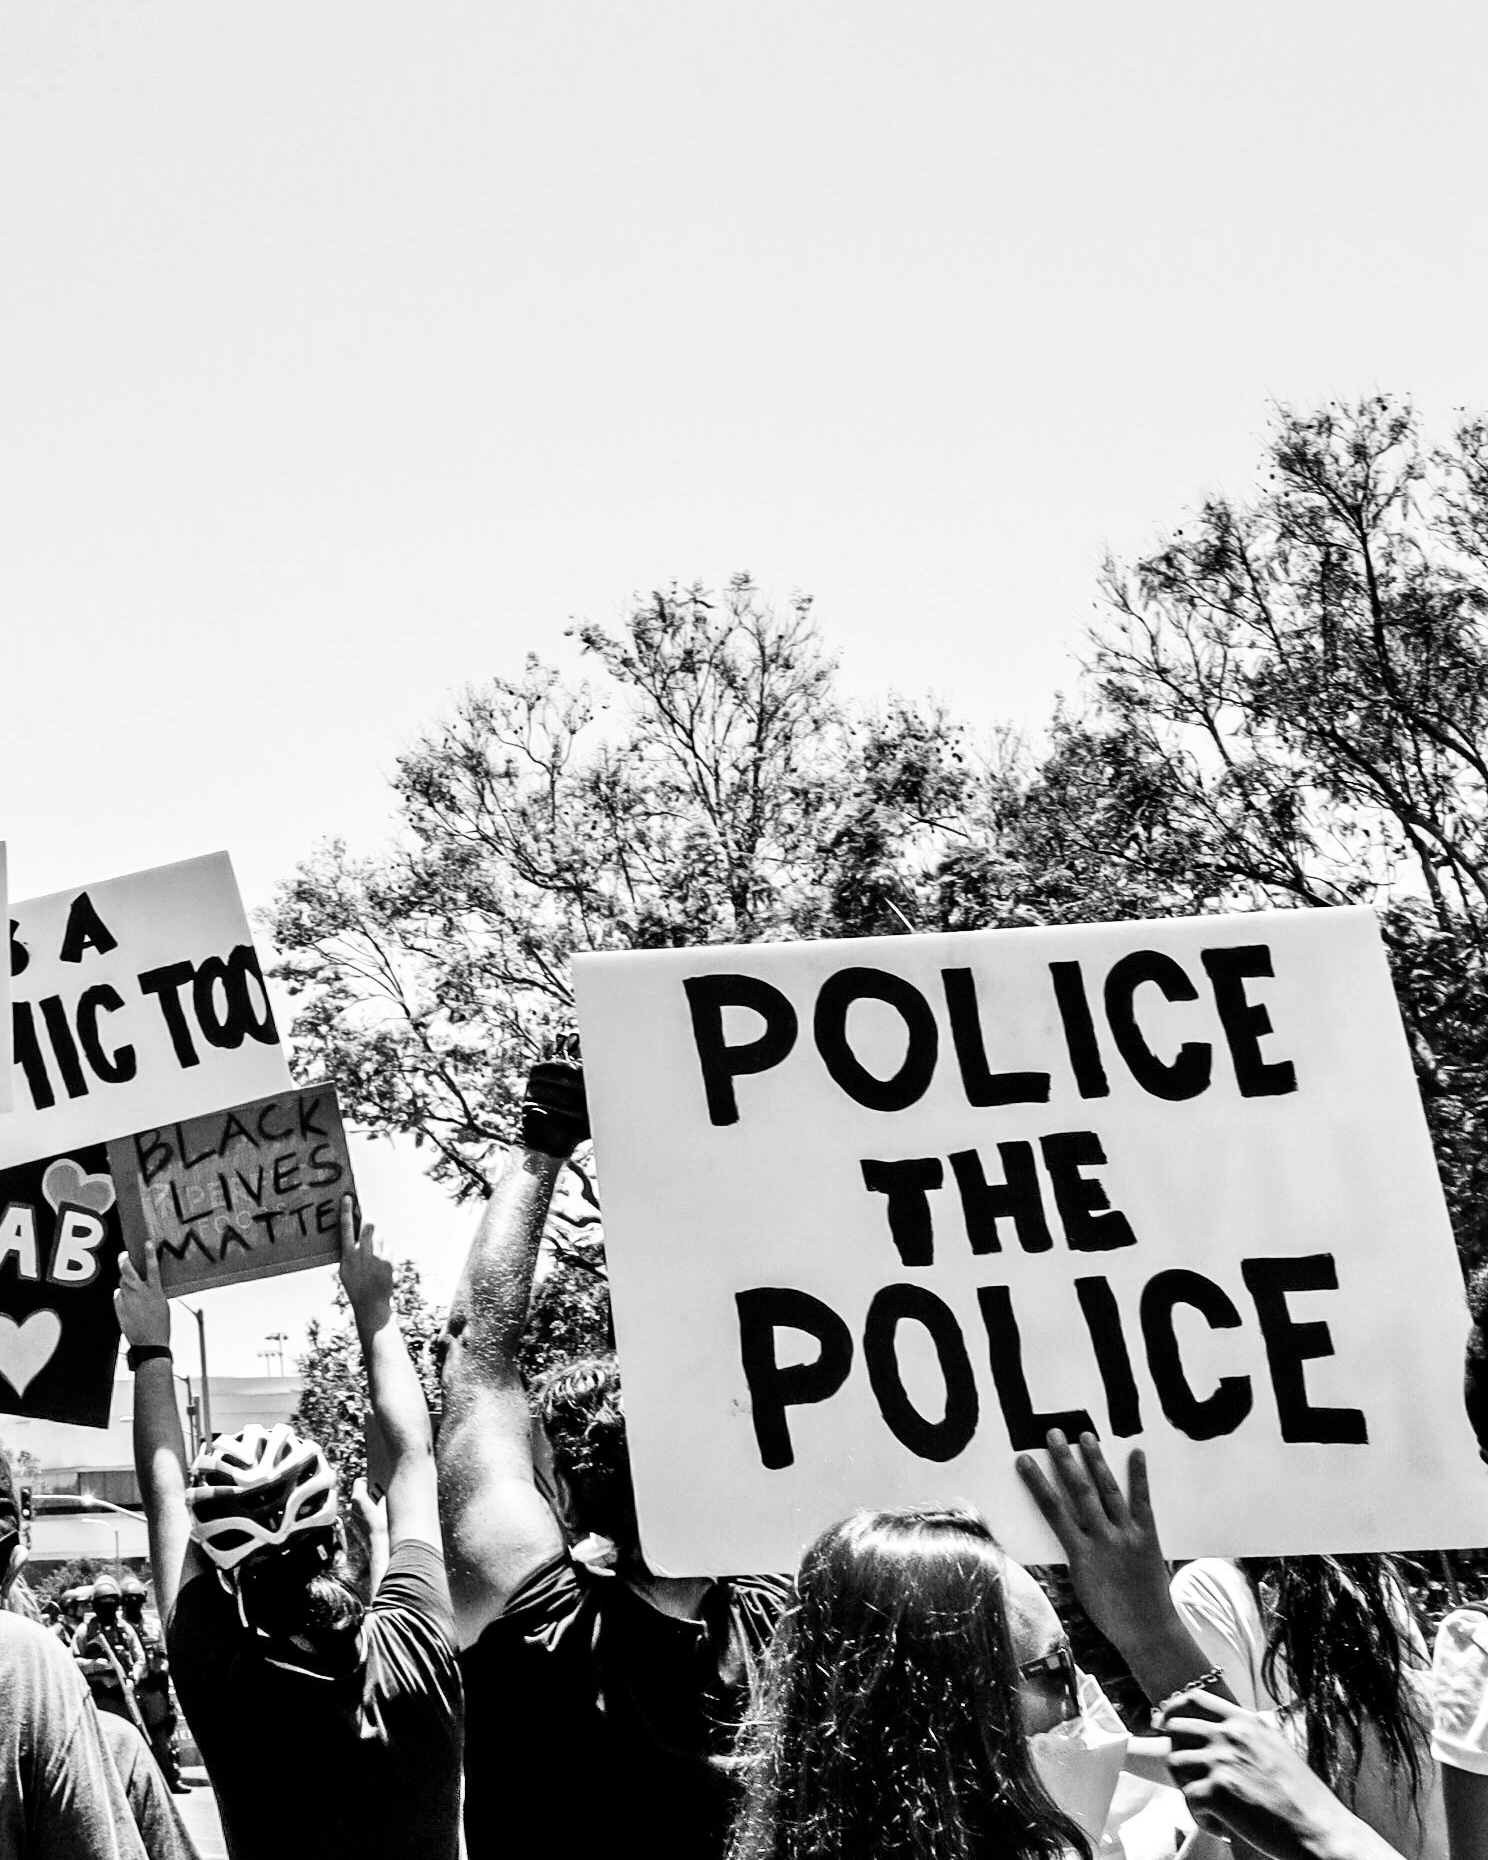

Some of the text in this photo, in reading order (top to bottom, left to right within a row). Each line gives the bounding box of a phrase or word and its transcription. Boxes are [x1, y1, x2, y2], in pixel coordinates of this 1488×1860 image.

[59, 891, 119, 963] A
[682, 944, 1298, 1127] POLICE
[133, 1096, 328, 1188] BLACK
[169, 1143, 343, 1225] LIVES
[156, 1197, 362, 1263] MATTE
[860, 1131, 1138, 1267] THE
[734, 1253, 1369, 1471] POLICE
